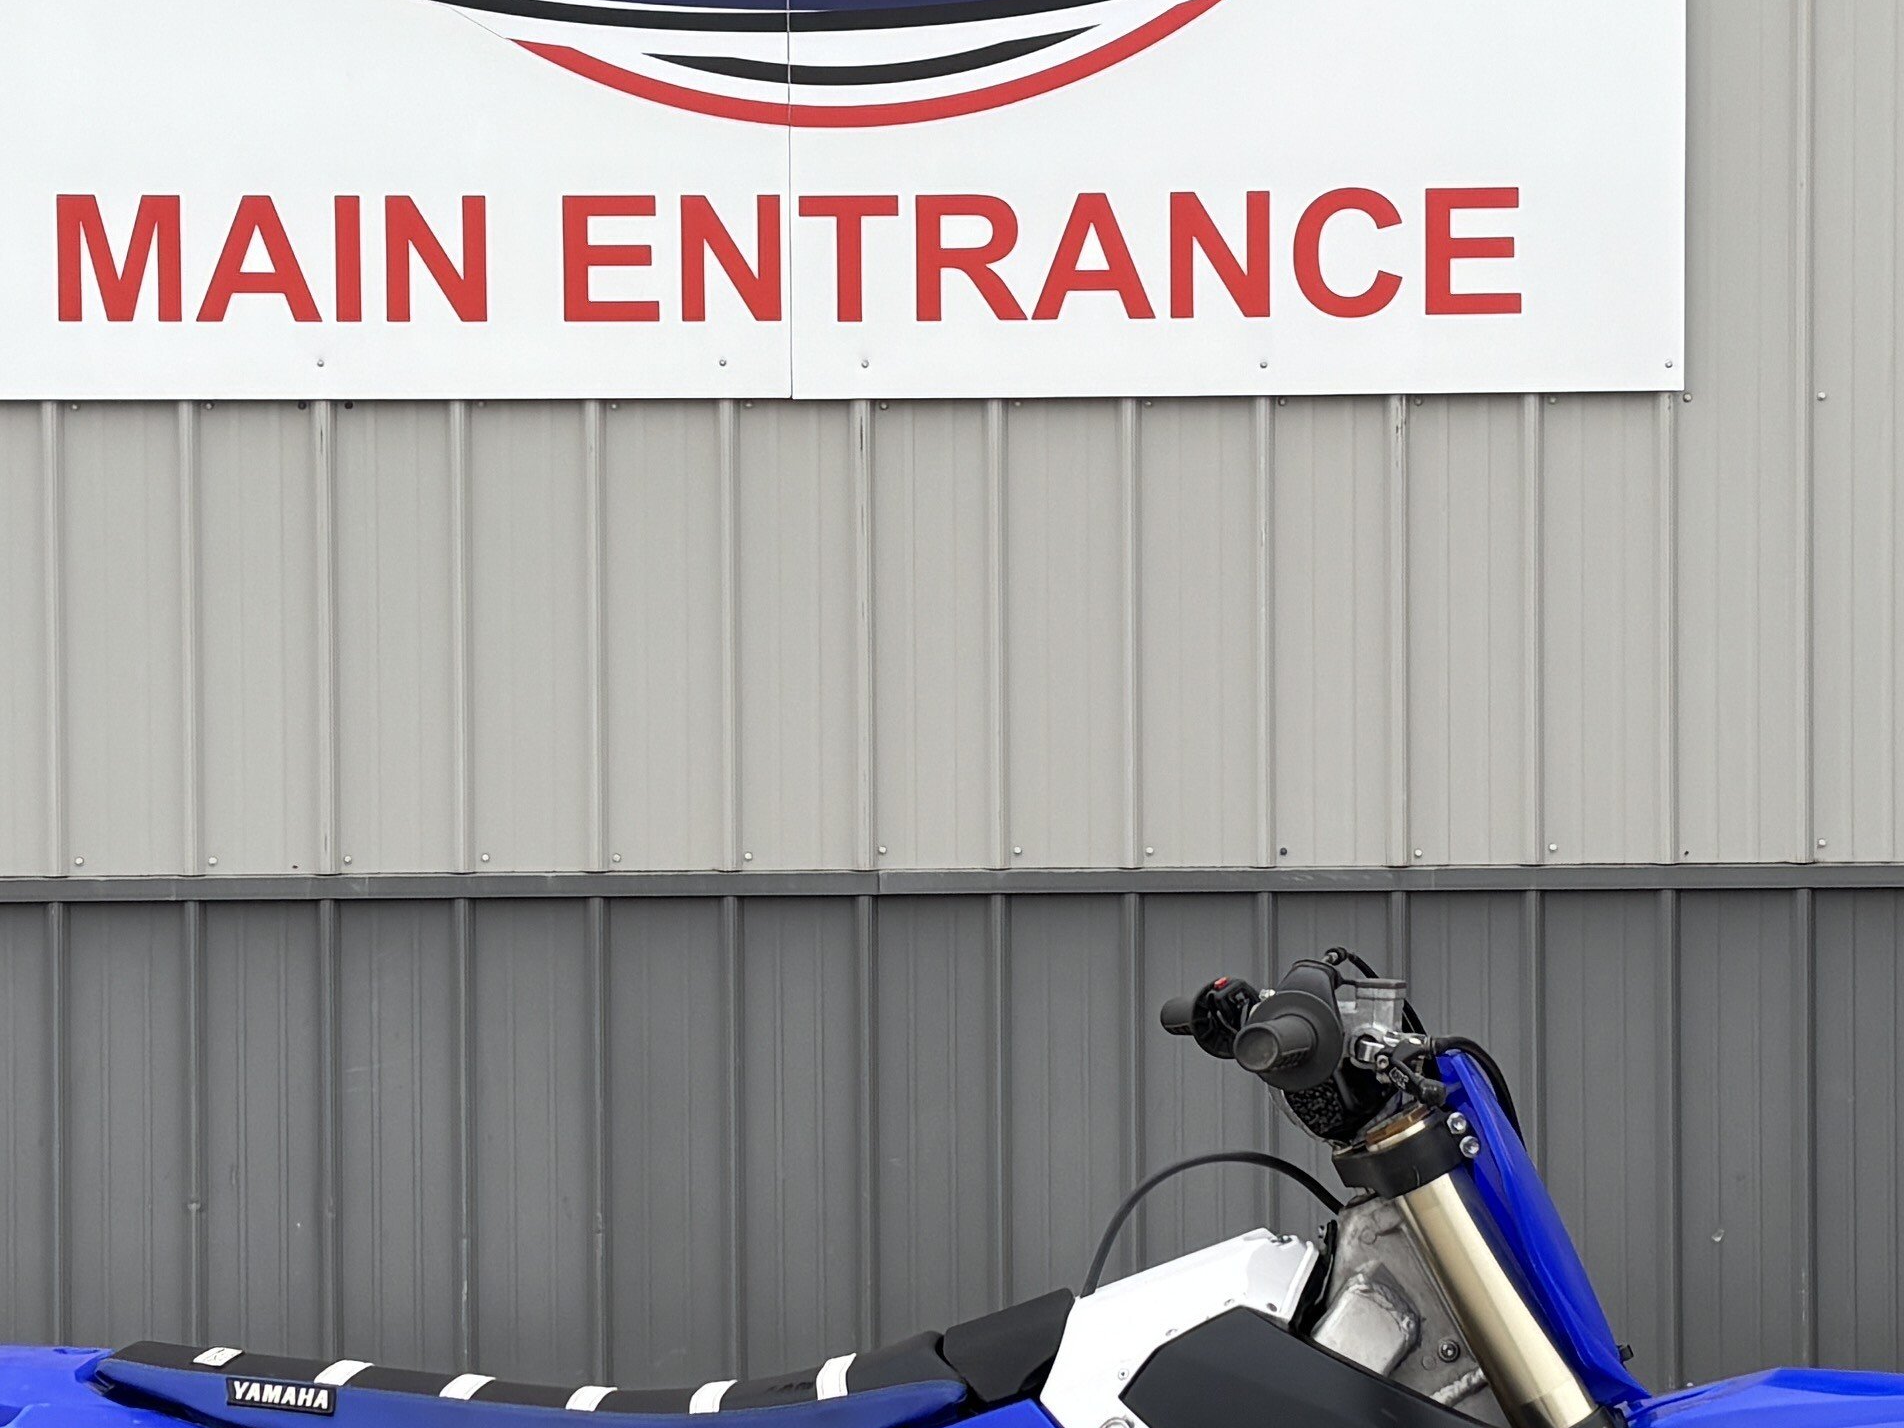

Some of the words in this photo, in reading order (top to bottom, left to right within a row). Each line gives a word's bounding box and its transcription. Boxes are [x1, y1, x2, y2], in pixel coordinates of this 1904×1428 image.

[55, 193, 488, 324] MAIN
[562, 186, 1523, 324] ENTRANCE
[233, 1380, 329, 1410] YAMAHA
